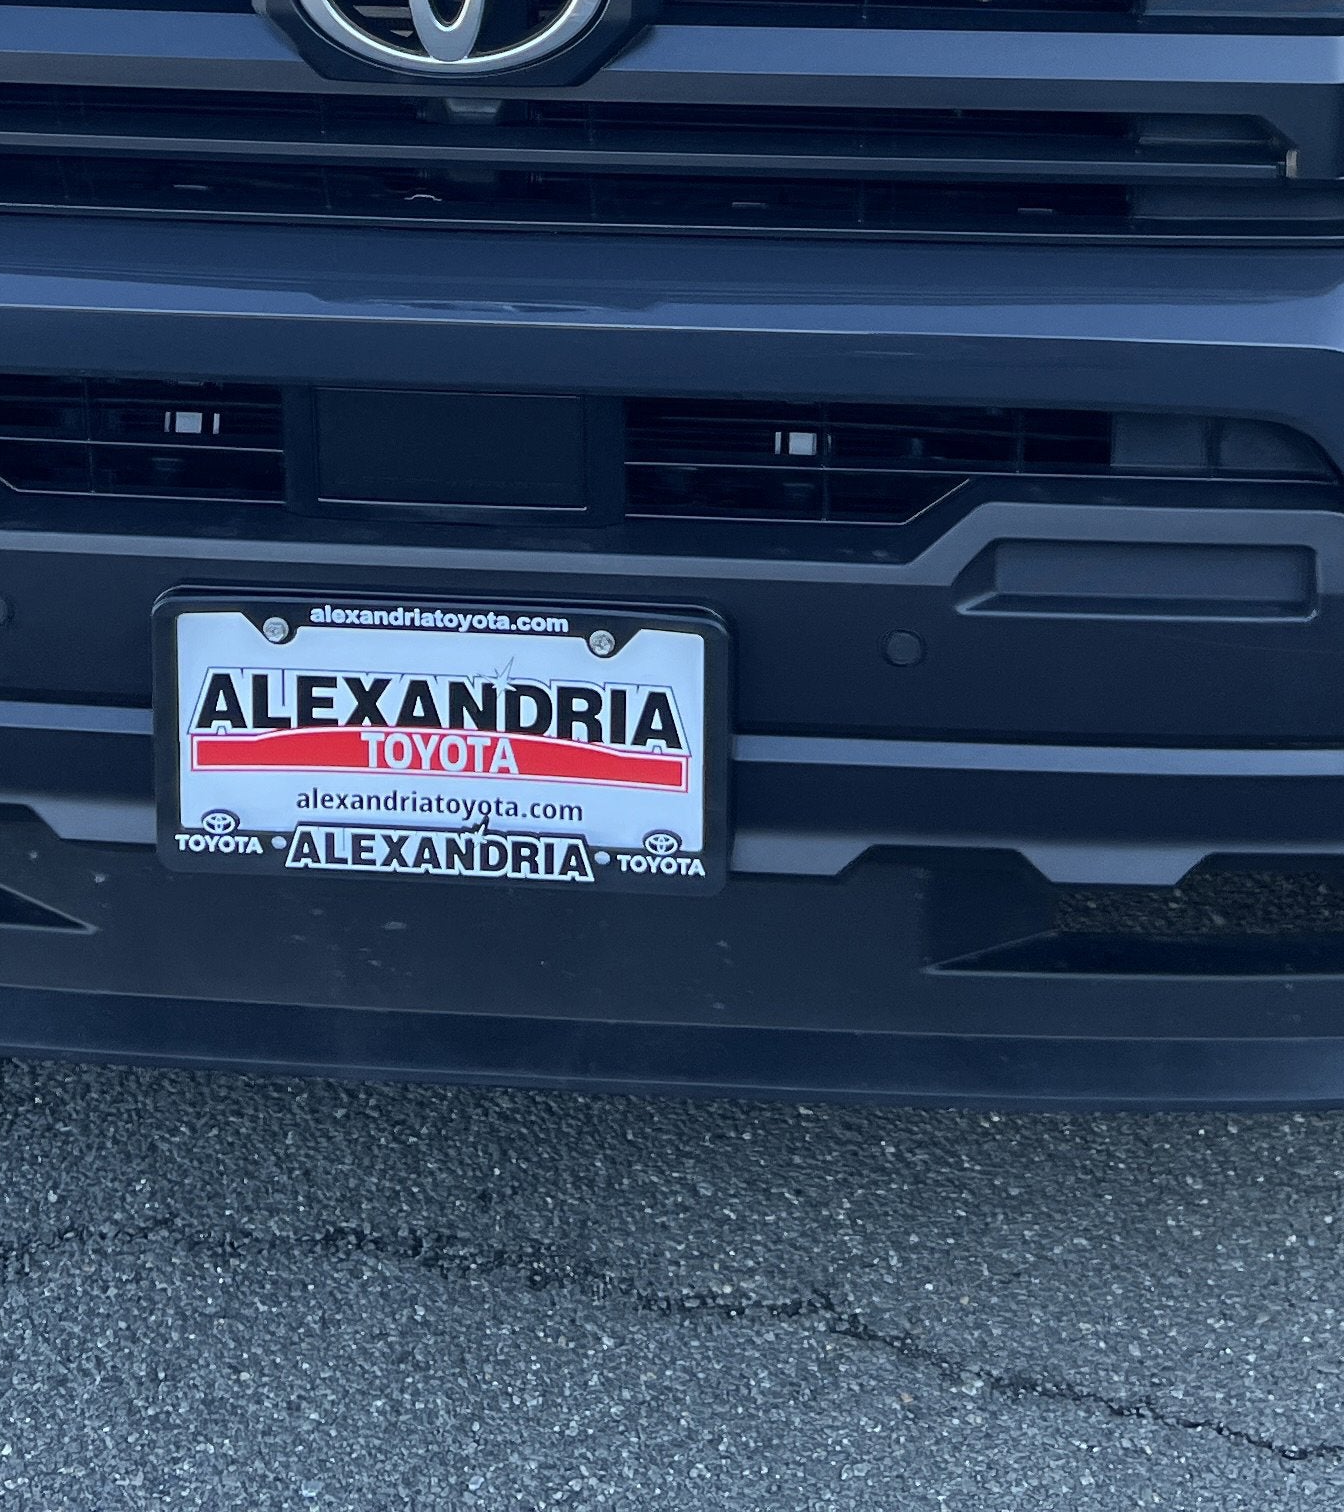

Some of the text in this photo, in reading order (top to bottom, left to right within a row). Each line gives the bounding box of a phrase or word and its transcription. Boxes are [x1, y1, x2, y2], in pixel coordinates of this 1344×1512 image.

[309, 604, 570, 633] alexandriatoyota.com
[195, 672, 685, 750] ALEXANDRIA
[360, 731, 520, 775] TOYOTA
[296, 787, 584, 821] alexandriatoyota.com
[173, 828, 706, 879] TOYOTA ALEXANDRIA TOYOTA
